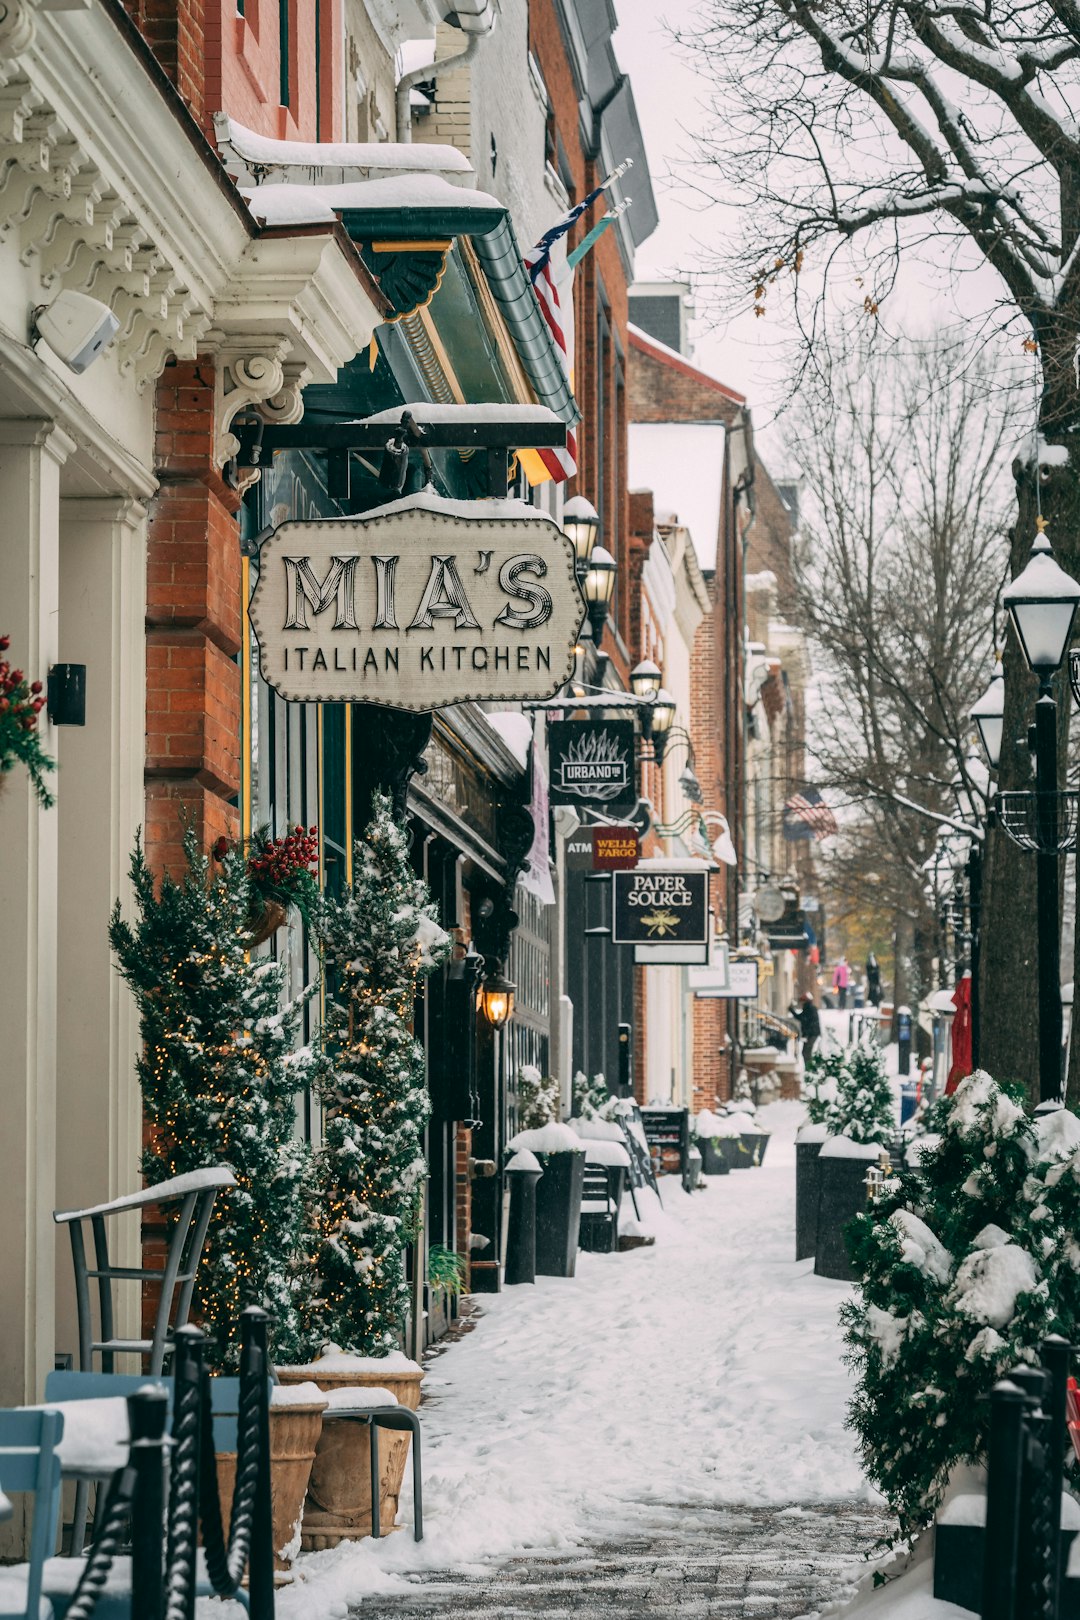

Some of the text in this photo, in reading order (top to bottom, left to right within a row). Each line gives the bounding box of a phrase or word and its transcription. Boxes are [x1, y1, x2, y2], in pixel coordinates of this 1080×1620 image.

[282, 551, 552, 630] MIA'S
[284, 646, 551, 671] ITALIAN KITCHEN
[567, 766, 611, 779] URBANO
[567, 842, 592, 853] ATM
[597, 840, 636, 848] WELLS
[598, 848, 636, 857] FARGO
[634, 876, 687, 891] PAPER
[628, 891, 693, 906] SOURCE
